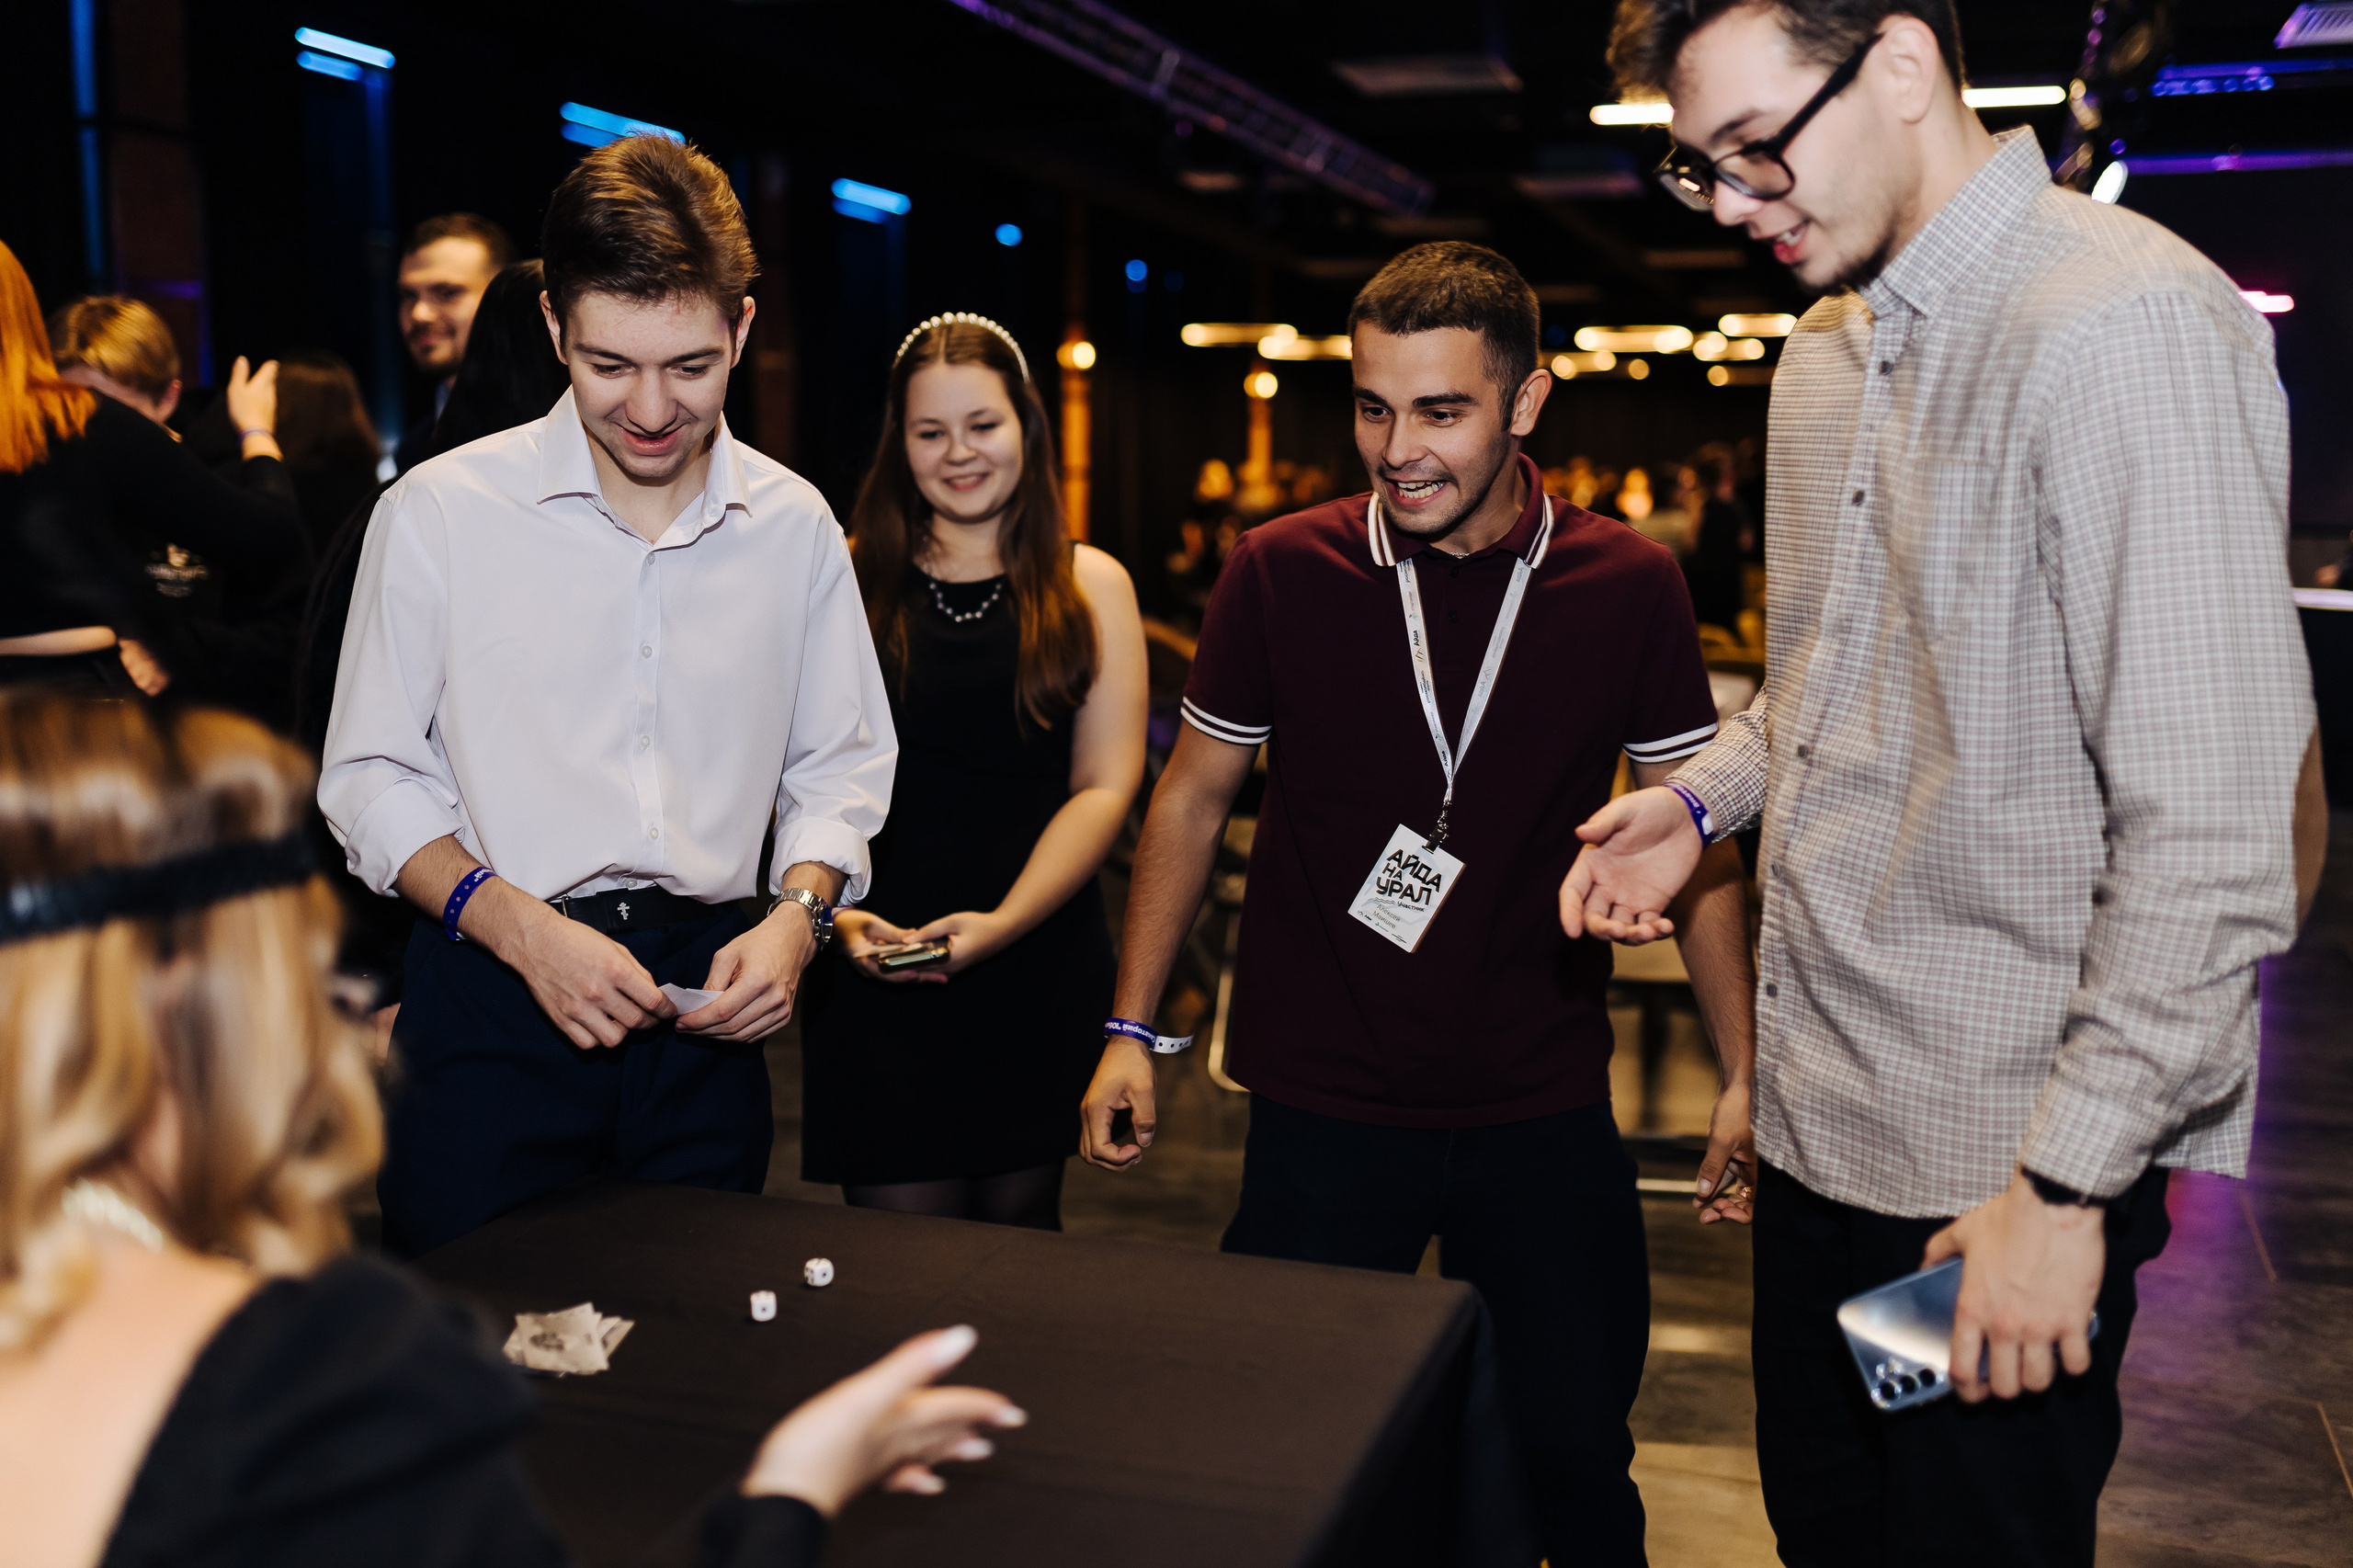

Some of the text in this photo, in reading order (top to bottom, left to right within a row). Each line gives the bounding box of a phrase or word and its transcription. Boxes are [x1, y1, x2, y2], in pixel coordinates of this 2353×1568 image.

[1381, 862, 1403, 881] НА
[1386, 848, 1442, 892] АЙДА
[1376, 876, 1432, 906] УРАЛ
[1376, 903, 1402, 923] Алексей
